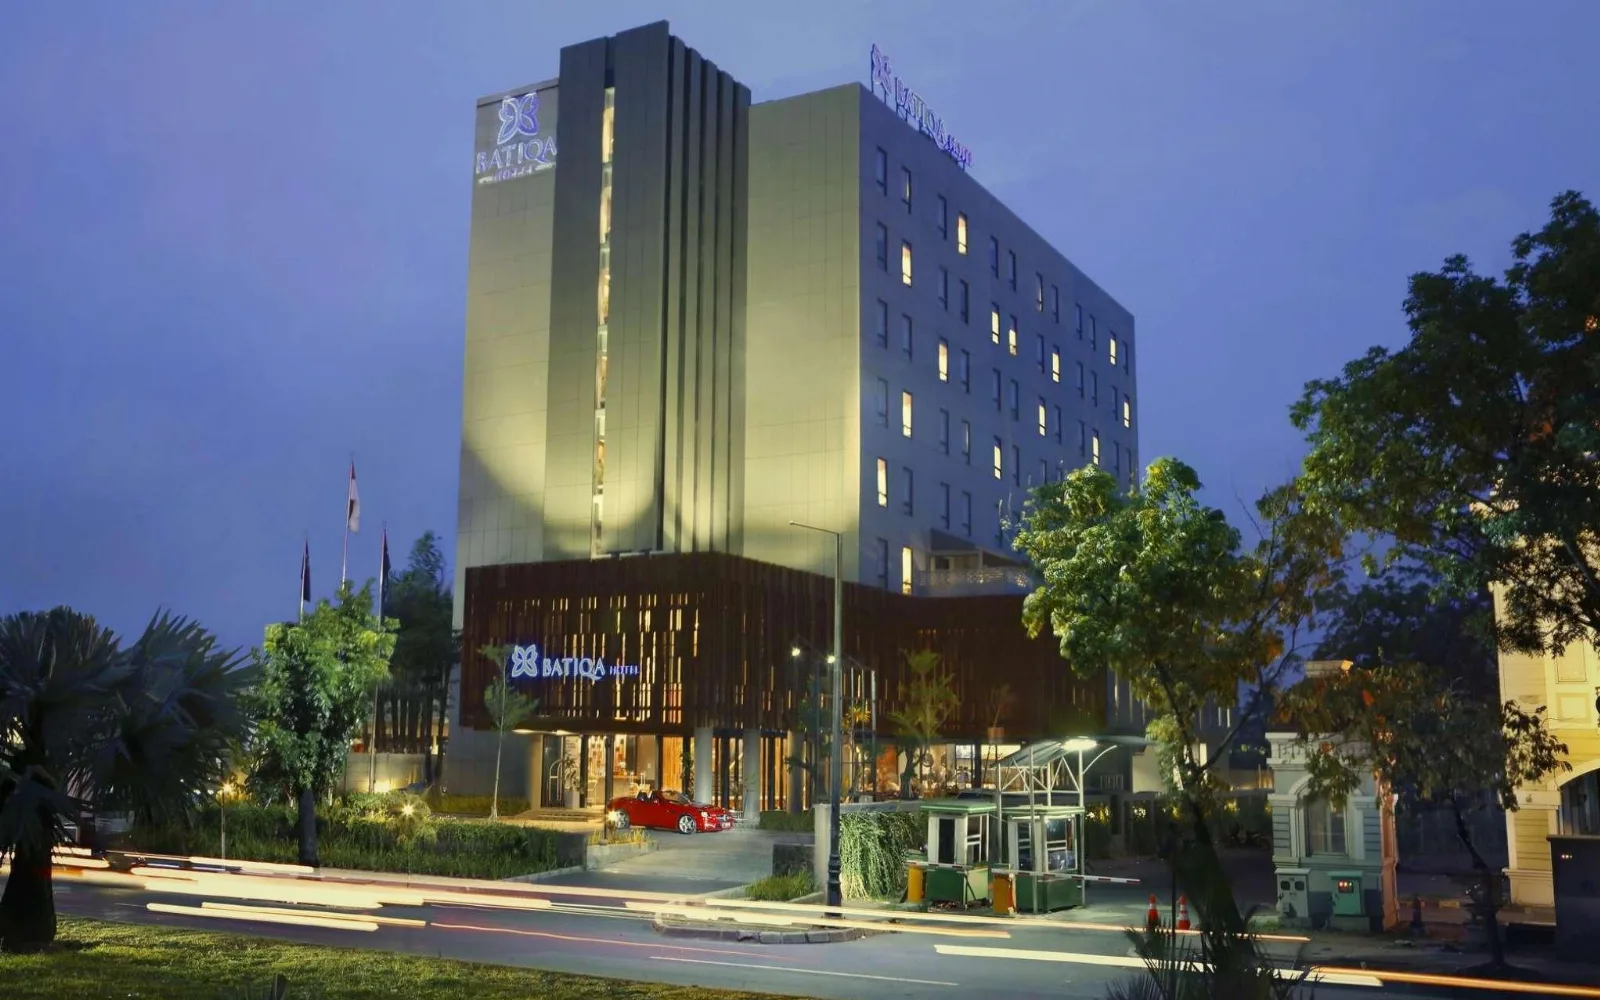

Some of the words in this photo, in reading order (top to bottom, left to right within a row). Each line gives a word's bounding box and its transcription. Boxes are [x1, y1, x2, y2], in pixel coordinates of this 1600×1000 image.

[475, 136, 557, 174] BATIQA
[542, 657, 606, 680] BATIQA
[609, 665, 639, 675] HOTEL
